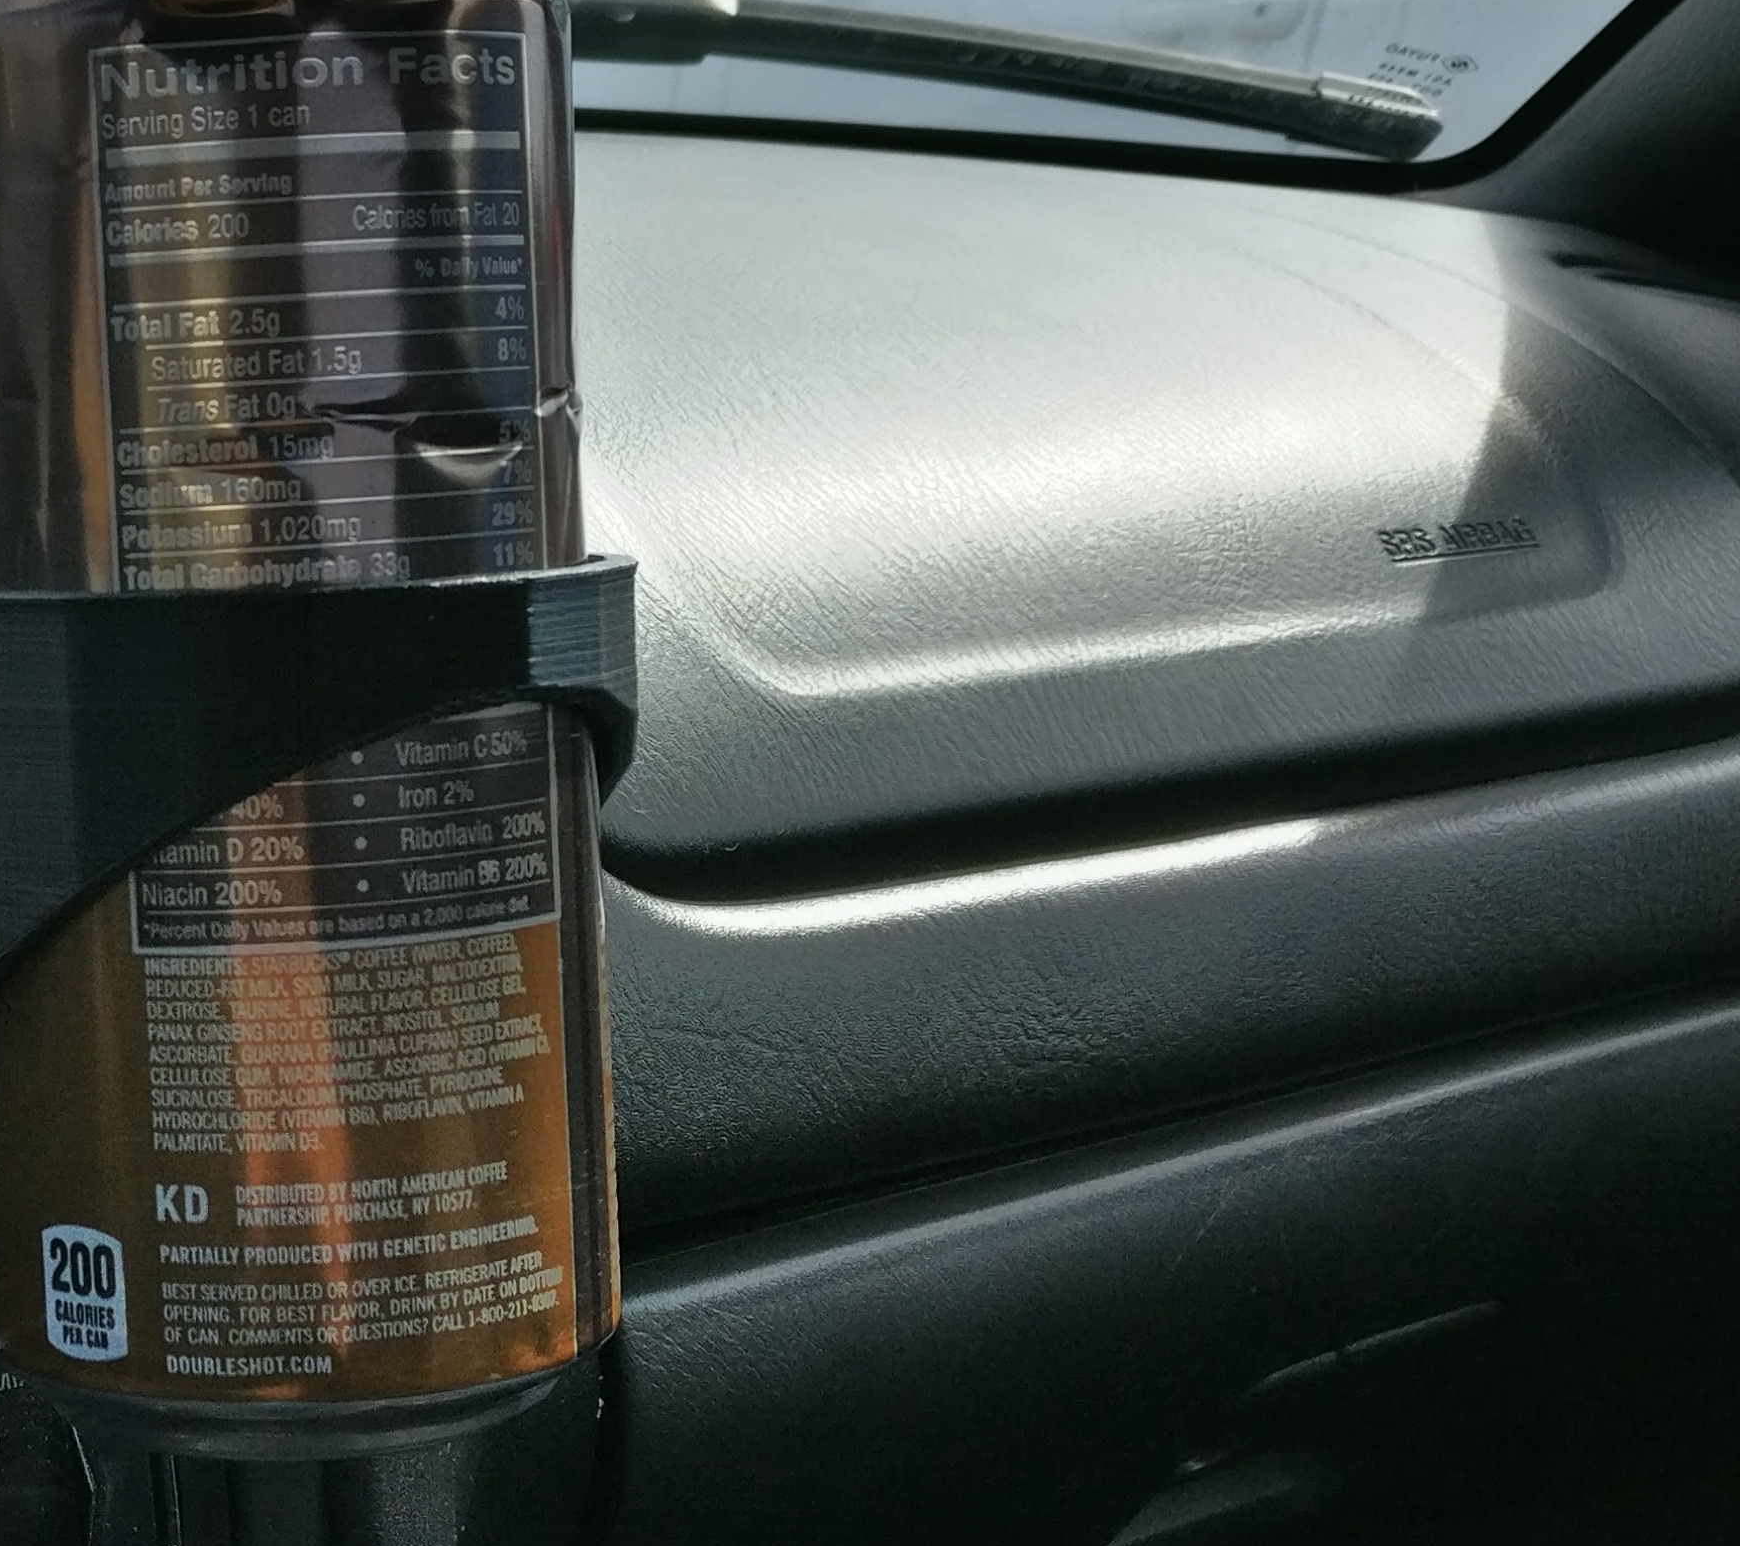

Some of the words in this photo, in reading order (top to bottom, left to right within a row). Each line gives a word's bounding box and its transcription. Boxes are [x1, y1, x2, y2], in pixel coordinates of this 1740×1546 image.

[101, 50, 365, 102] Nutrition
[389, 46, 517, 86] Facts
[102, 109, 183, 140] Serving
[190, 104, 240, 133] Size
[248, 104, 259, 129] 1
[269, 103, 312, 128] can
[105, 180, 176, 203] Amount
[180, 176, 213, 199] Per
[219, 172, 293, 198] Serving
[107, 216, 199, 247] Calories
[206, 212, 250, 241] 200
[352, 202, 426, 232] Calories
[428, 201, 471, 229] from
[473, 199, 499, 227] Fat
[502, 200, 523, 226] 20
[110, 313, 174, 342] Total
[178, 310, 221, 339] Fat
[229, 308, 281, 339] 2.5g
[494, 295, 526, 322] 4%
[150, 350, 261, 382] Saturated
[268, 348, 305, 376] Fat
[311, 344, 363, 375] 1.5g
[497, 337, 528, 363] 8%
[157, 396, 220, 425] Trans
[223, 393, 263, 420] Fat
[266, 391, 296, 419] 0g
[118, 434, 260, 467] Cholesterol
[267, 432, 336, 462] 15mg
[121, 479, 214, 510] Sodium
[221, 476, 302, 506] 160mg
[491, 500, 534, 528] 29%
[122, 521, 253, 550] Potassium
[126, 565, 187, 592] Total
[189, 553, 362, 591] Carbohydrate
[368, 551, 412, 582] 33g
[493, 541, 534, 568] 11%
[396, 734, 469, 767] Vitamin
[473, 732, 489, 759] C
[490, 730, 528, 757] 50%
[398, 784, 439, 811] Iron
[443, 779, 476, 807] 2%
[400, 822, 494, 853] Riboflavin
[500, 811, 547, 841] 200%
[226, 837, 245, 864] D
[249, 835, 306, 864] 20%
[402, 864, 475, 893] Vitamin
[504, 852, 548, 881] 200%
[141, 881, 209, 907] Niacin
[214, 879, 283, 908] 200%
[252, 918, 307, 938] Values
[266, 1020, 307, 1041] ROOT
[151, 1110, 278, 1131] HYDROCHLORIDE
[236, 1130, 296, 1153] VITAMIN
[235, 1182, 326, 1206] DISTRIBUTED
[327, 1180, 347, 1204] BY
[349, 1176, 398, 1202] NORTH
[400, 1168, 466, 1196] AMERICAN
[466, 1159, 509, 1188] COFFEE
[154, 1182, 210, 1225] KD
[411, 1195, 430, 1217] NY
[159, 1243, 241, 1267] PARTIALLY
[243, 1243, 335, 1267] PRODUCED
[336, 1239, 380, 1264] WITH
[382, 1232, 447, 1259] GENETIC
[49, 1236, 117, 1299] 200
[160, 1280, 198, 1301] BEST
[200, 1282, 259, 1303] SERVED
[260, 1281, 324, 1303] CHILLED
[326, 1280, 349, 1299] OR
[351, 1276, 391, 1299] OVER
[424, 1258, 509, 1291] REFRIGERATE
[509, 1249, 544, 1275] AFTER
[55, 1299, 116, 1331] CALORIES
[238, 1304, 272, 1325] FOR
[275, 1303, 318, 1324] BEST
[320, 1299, 386, 1324] FLAVOR,
[389, 1293, 438, 1317] DRINK
[439, 1289, 461, 1310] BY
[462, 1283, 497, 1307] DATE
[499, 1278, 519, 1300] ON
[62, 1324, 84, 1345] PER
[163, 1324, 184, 1345] OF
[227, 1326, 315, 1347] COMMENTS
[316, 1325, 339, 1346] OR
[341, 1316, 429, 1345] QUESTIONS?
[431, 1312, 466, 1334] CALL
[166, 1354, 334, 1377] DOUBLESHOT.COM
